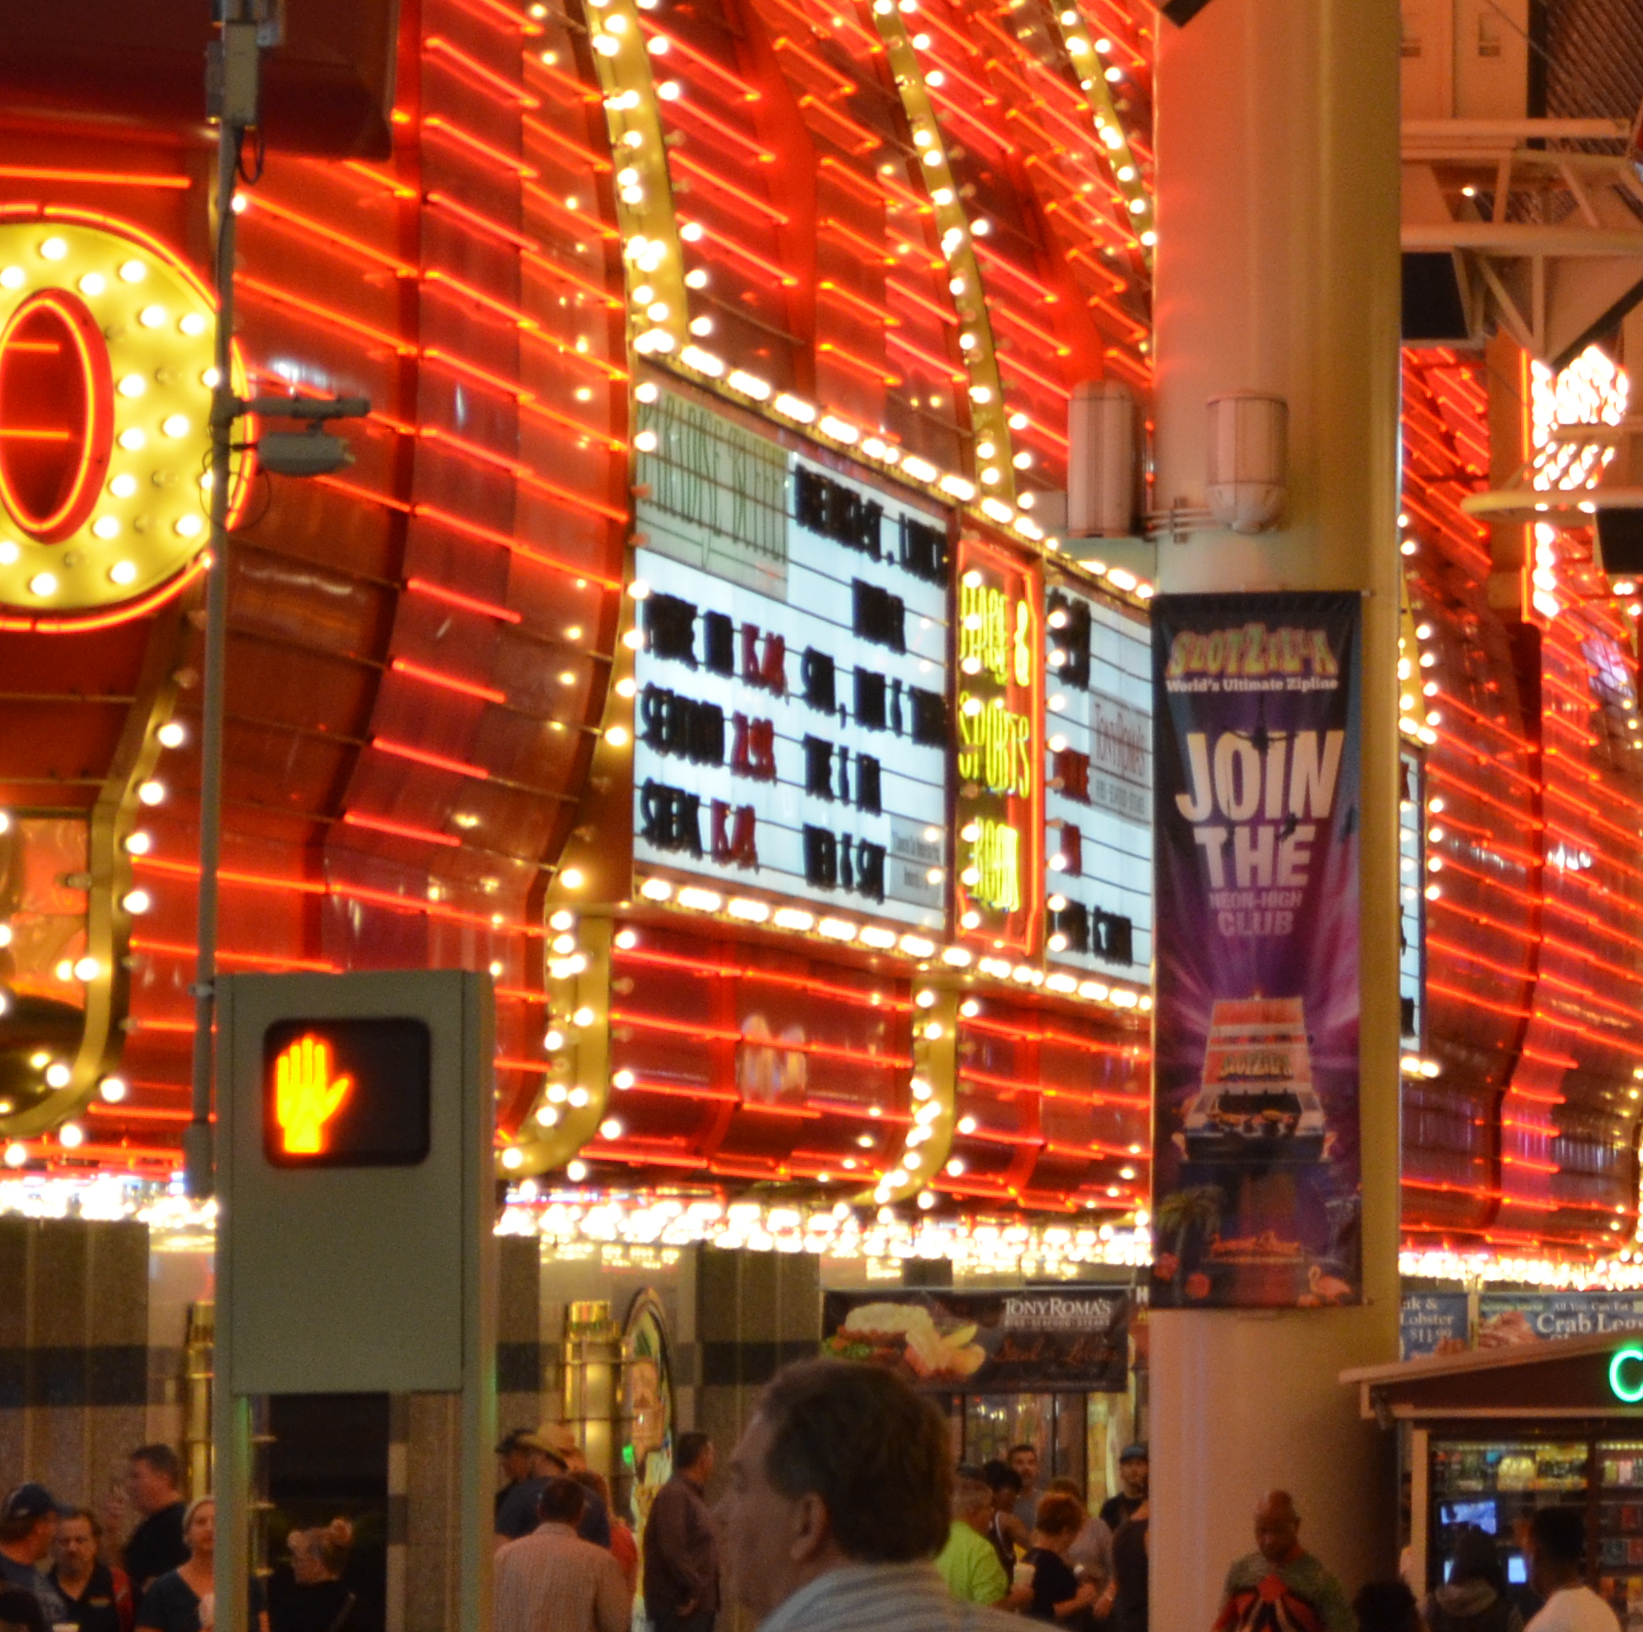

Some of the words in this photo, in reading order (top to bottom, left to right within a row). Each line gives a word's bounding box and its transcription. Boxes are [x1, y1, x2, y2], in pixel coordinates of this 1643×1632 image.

[1166, 678, 1220, 693] World's
[1223, 677, 1283, 692] Ultimate
[1285, 676, 1339, 692] Zipline
[958, 691, 1031, 799] SPORTS
[1174, 729, 1345, 822] JOIN
[1193, 825, 1316, 888] THE
[1209, 890, 1303, 910] NEON-HIGH
[1217, 911, 1294, 937] CLUB
[1003, 1298, 1048, 1316] TONY
[1048, 1297, 1112, 1317] ROMA'S
[1400, 1312, 1454, 1327] Lobster
[1536, 1312, 1592, 1335] Crab
